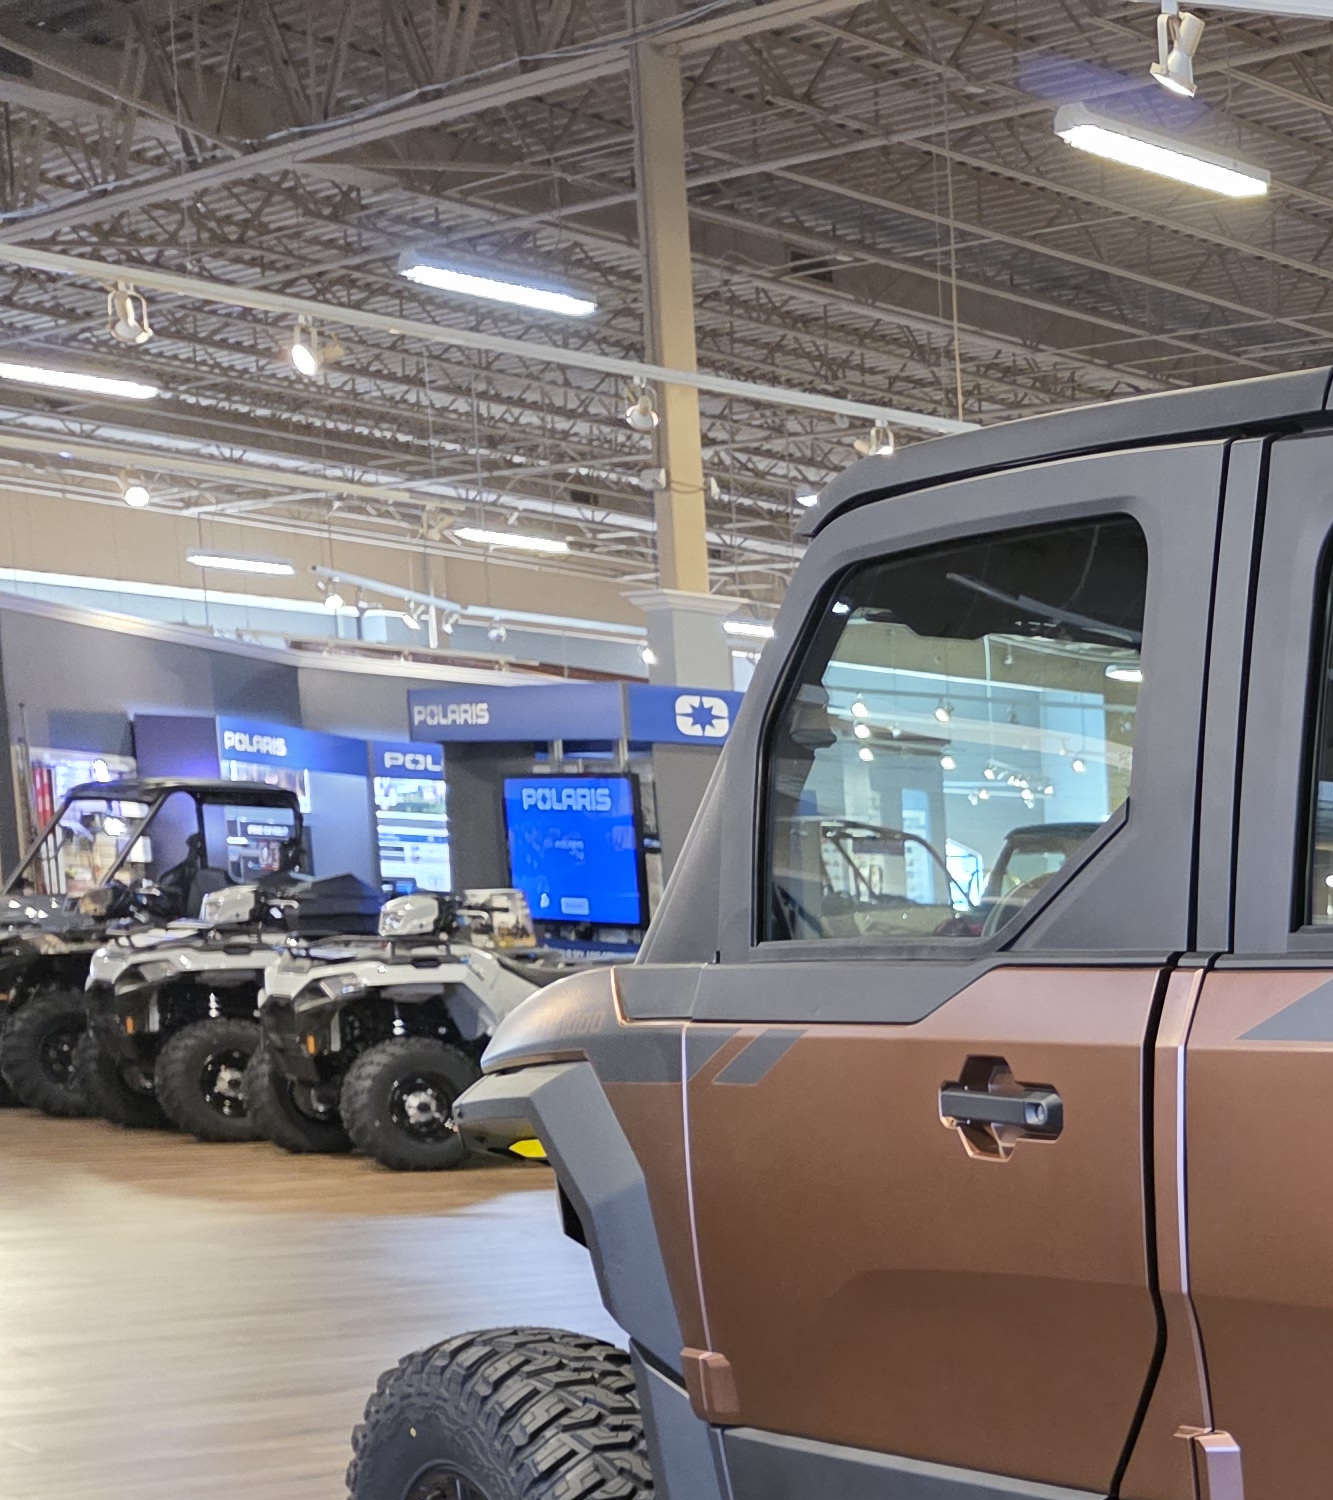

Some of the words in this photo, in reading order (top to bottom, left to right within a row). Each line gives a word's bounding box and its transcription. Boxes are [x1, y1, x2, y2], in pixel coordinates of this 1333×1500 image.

[413, 703, 490, 726] POLARIS
[224, 730, 287, 757] POLARIS
[522, 788, 612, 811] POLARIS
